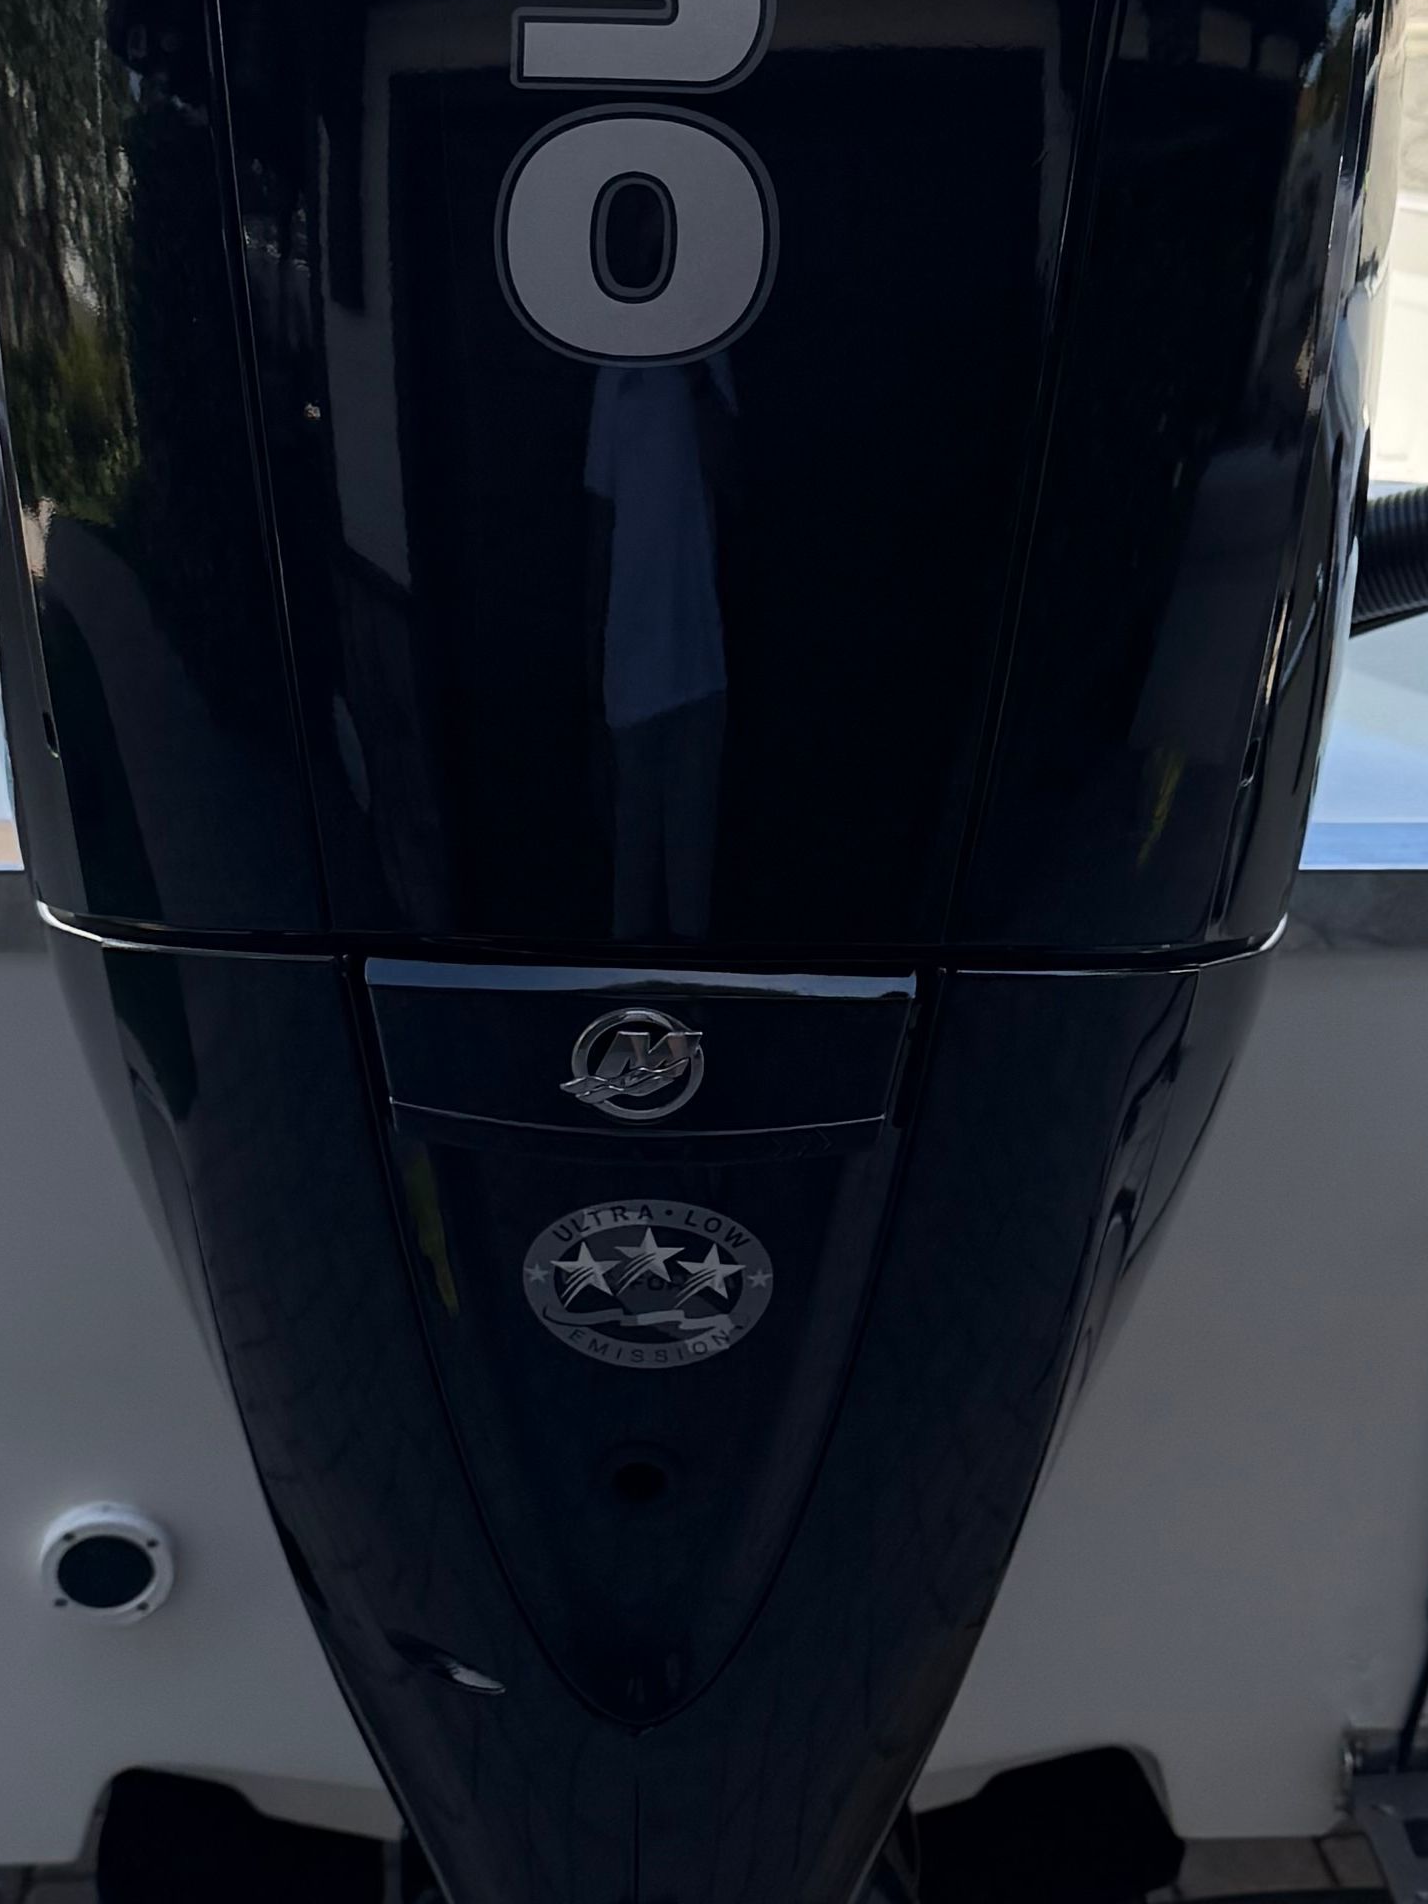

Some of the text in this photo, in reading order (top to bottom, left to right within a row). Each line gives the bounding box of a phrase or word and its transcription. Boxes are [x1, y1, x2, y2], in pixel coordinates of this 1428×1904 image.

[552, 1204, 751, 1249] ULTRA LOW
[568, 1327, 731, 1364] EMISSION
